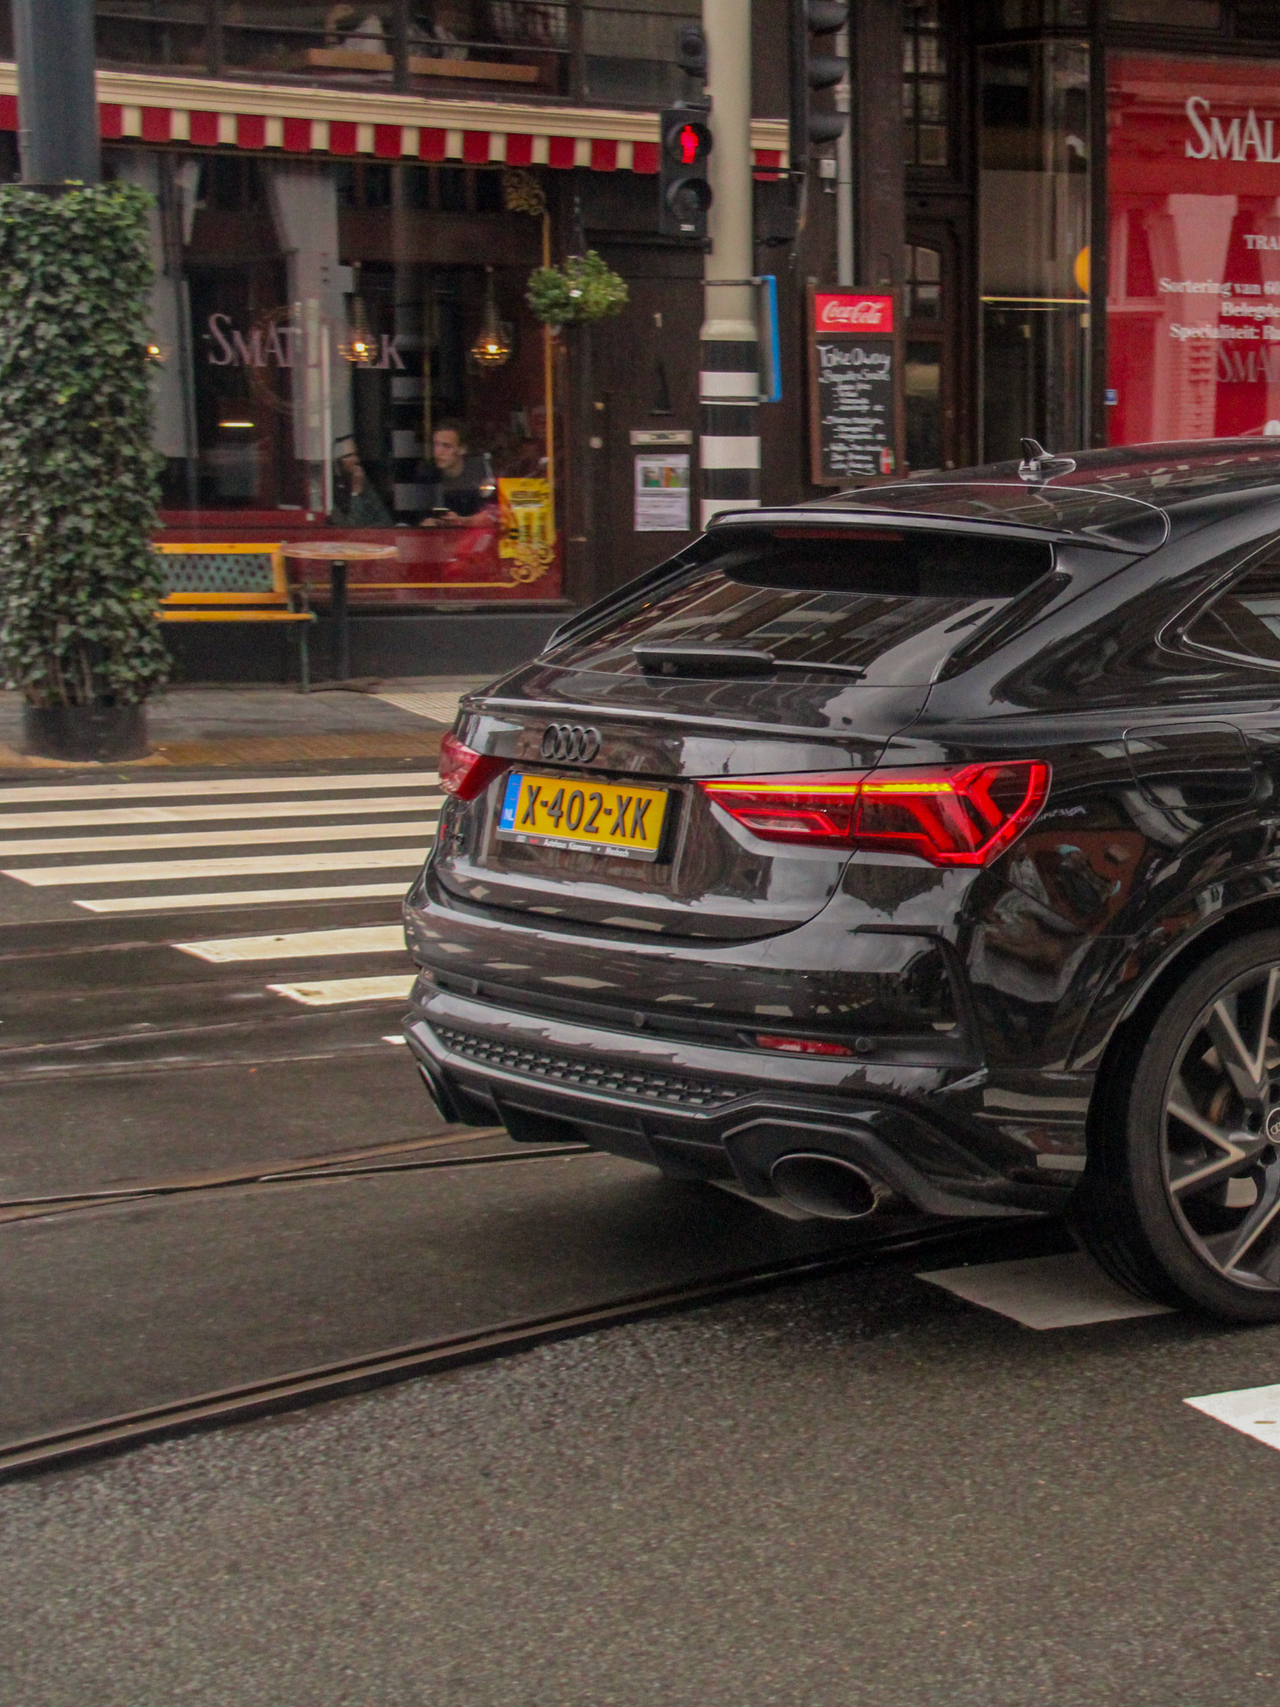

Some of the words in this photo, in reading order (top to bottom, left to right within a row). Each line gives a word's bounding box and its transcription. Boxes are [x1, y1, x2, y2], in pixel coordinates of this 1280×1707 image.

[1159, 277, 1231, 298] Sortering
[1234, 282, 1261, 295] van
[1169, 323, 1260, 342] Specialiteit:
[504, 808, 514, 821] NL
[521, 785, 652, 840] X-402-XK
